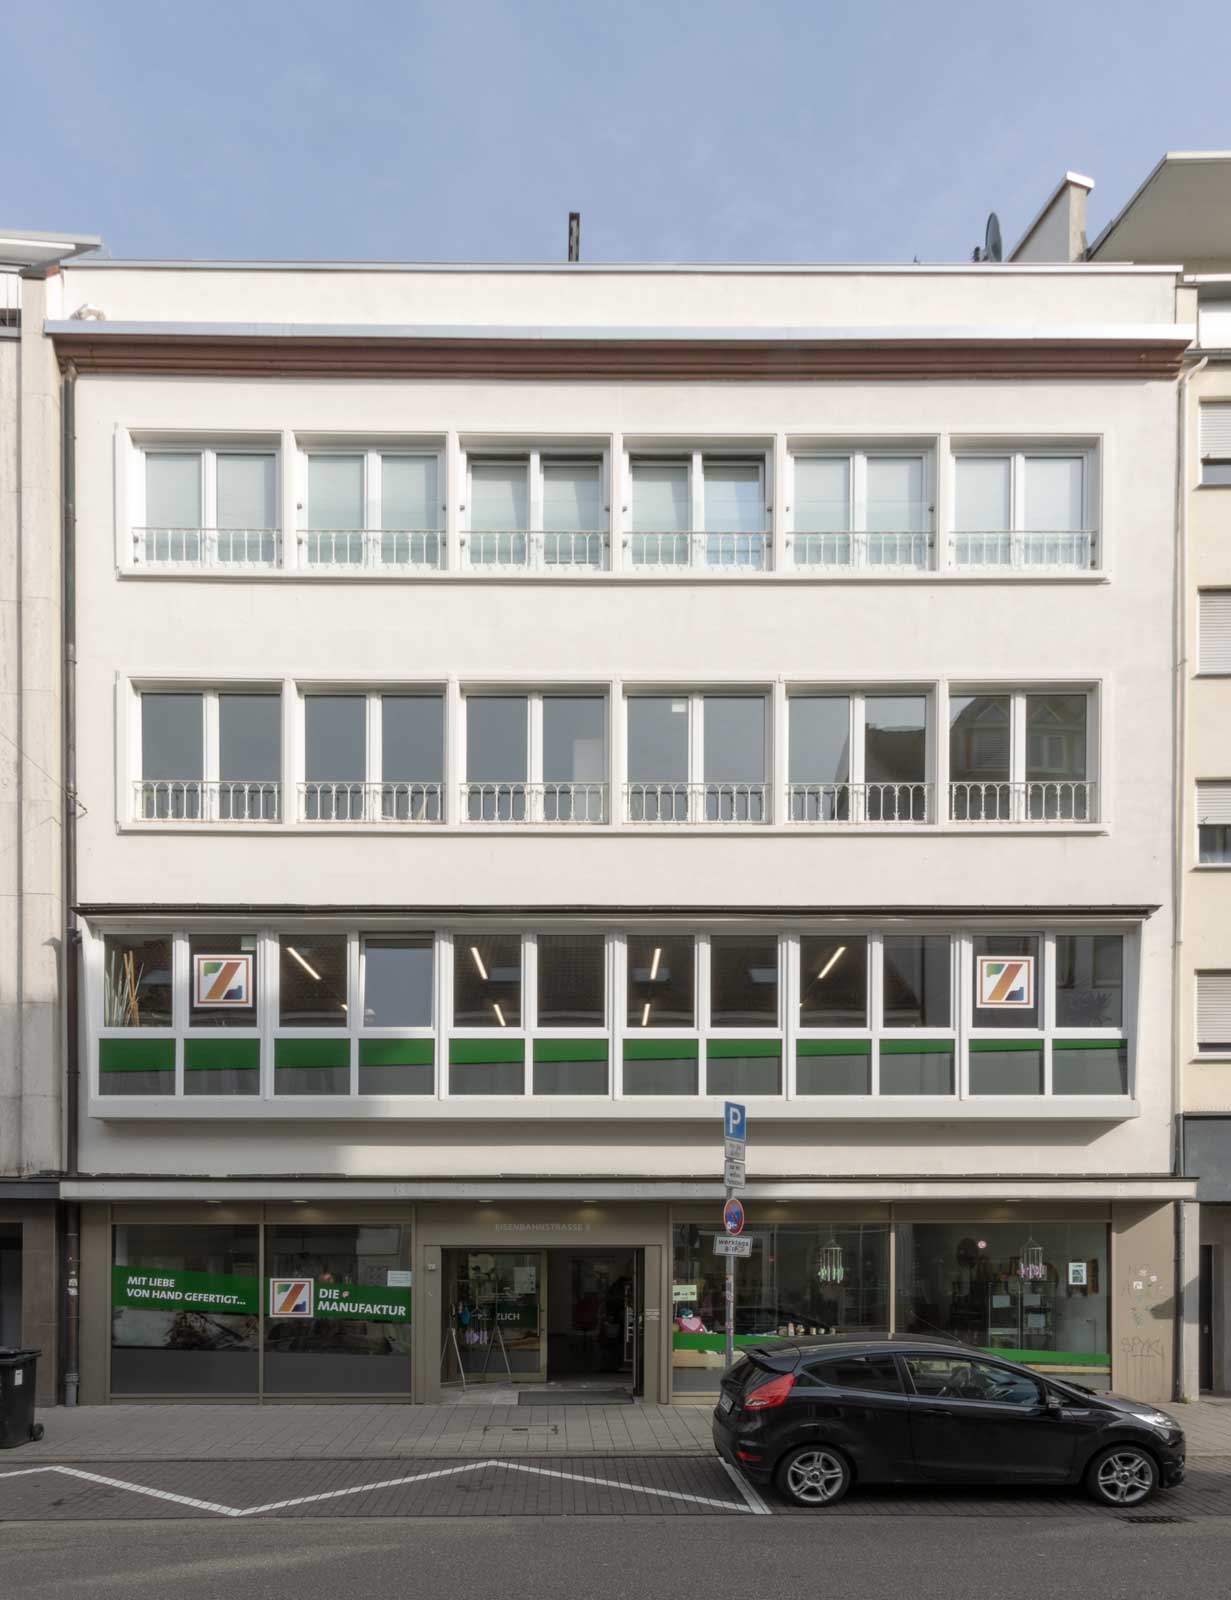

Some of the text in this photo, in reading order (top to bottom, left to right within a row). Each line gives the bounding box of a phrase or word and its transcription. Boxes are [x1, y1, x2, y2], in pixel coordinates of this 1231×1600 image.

[729, 1107, 741, 1134] P
[127, 1276, 175, 1288] MIT LIEBE
[126, 1288, 246, 1305] VON HAND GEFERTIGT...
[319, 1288, 340, 1300] DIE
[317, 1301, 407, 1316] MANUFAKTUR
